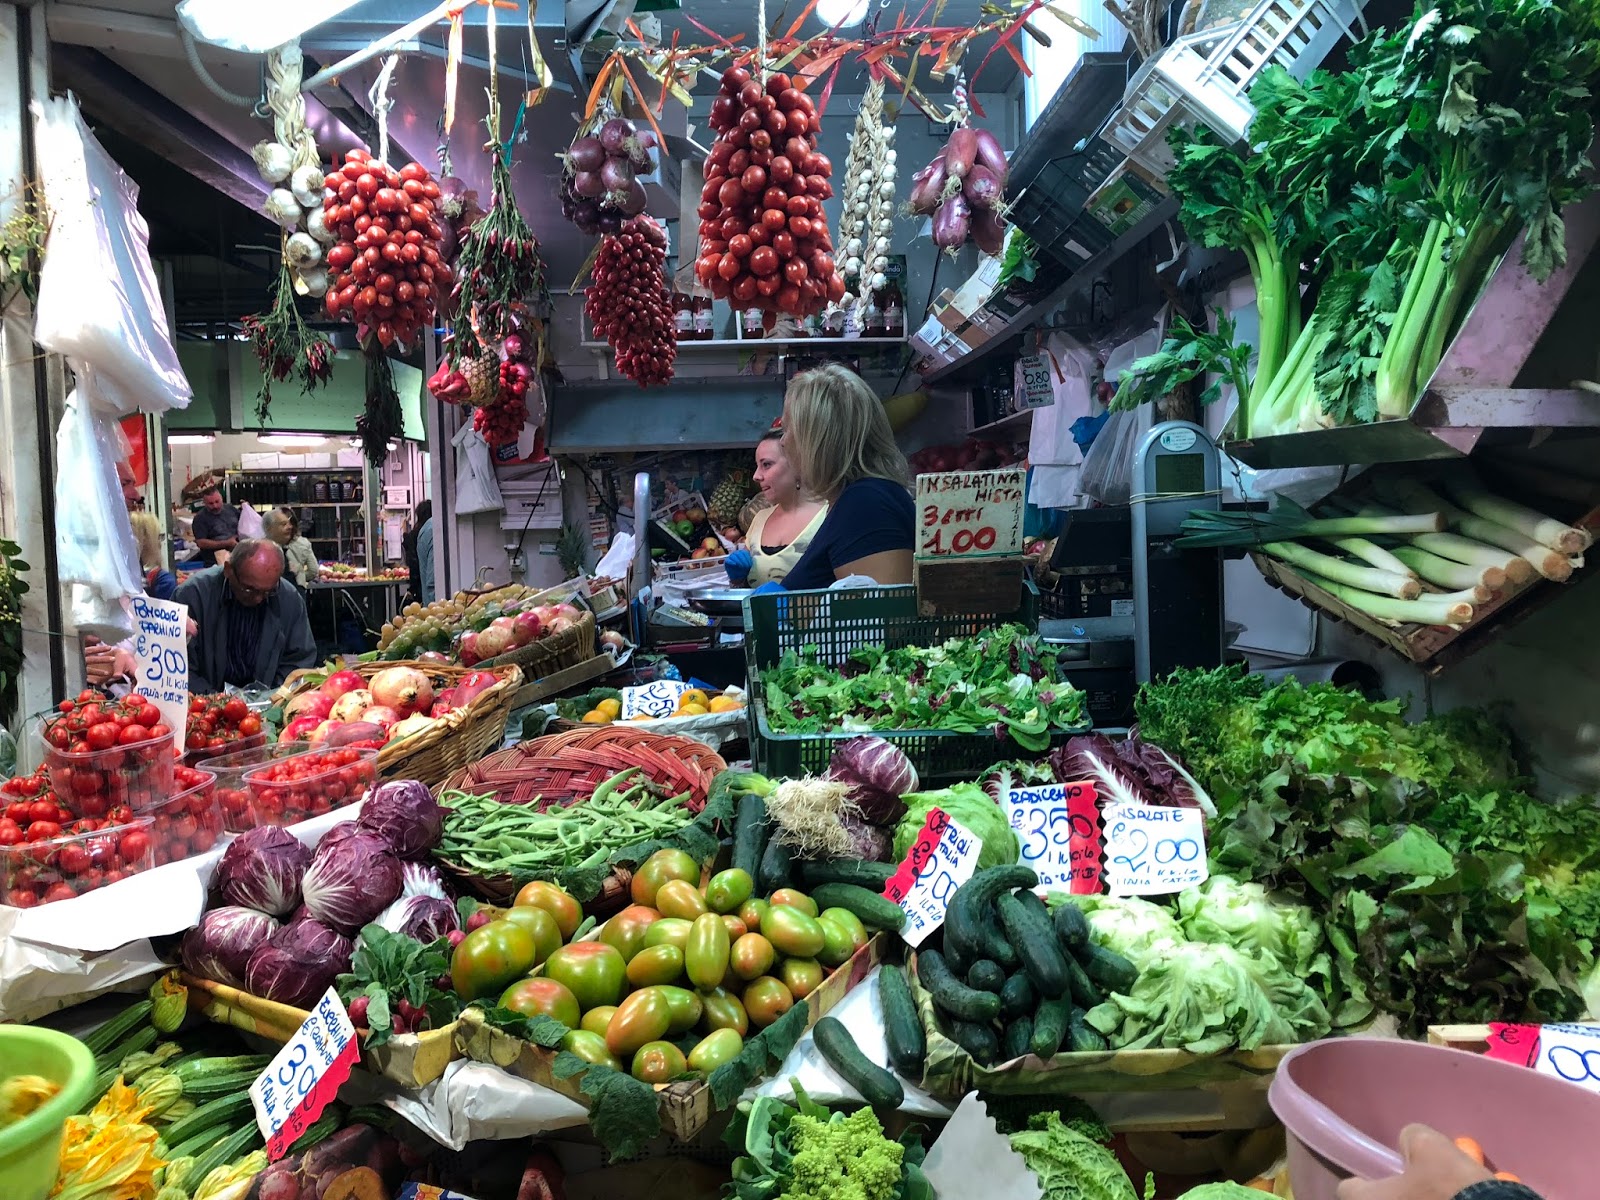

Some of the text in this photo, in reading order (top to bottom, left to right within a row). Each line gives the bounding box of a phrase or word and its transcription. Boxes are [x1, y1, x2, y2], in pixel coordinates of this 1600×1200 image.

[1024, 370, 1050, 385] 0,80
[919, 473, 1020, 494] INSALATINA
[975, 488, 1022, 503] MISTA
[923, 526, 997, 555] 1,00
[1106, 803, 1184, 823] INSALATE
[1496, 1028, 1520, 1045] €
